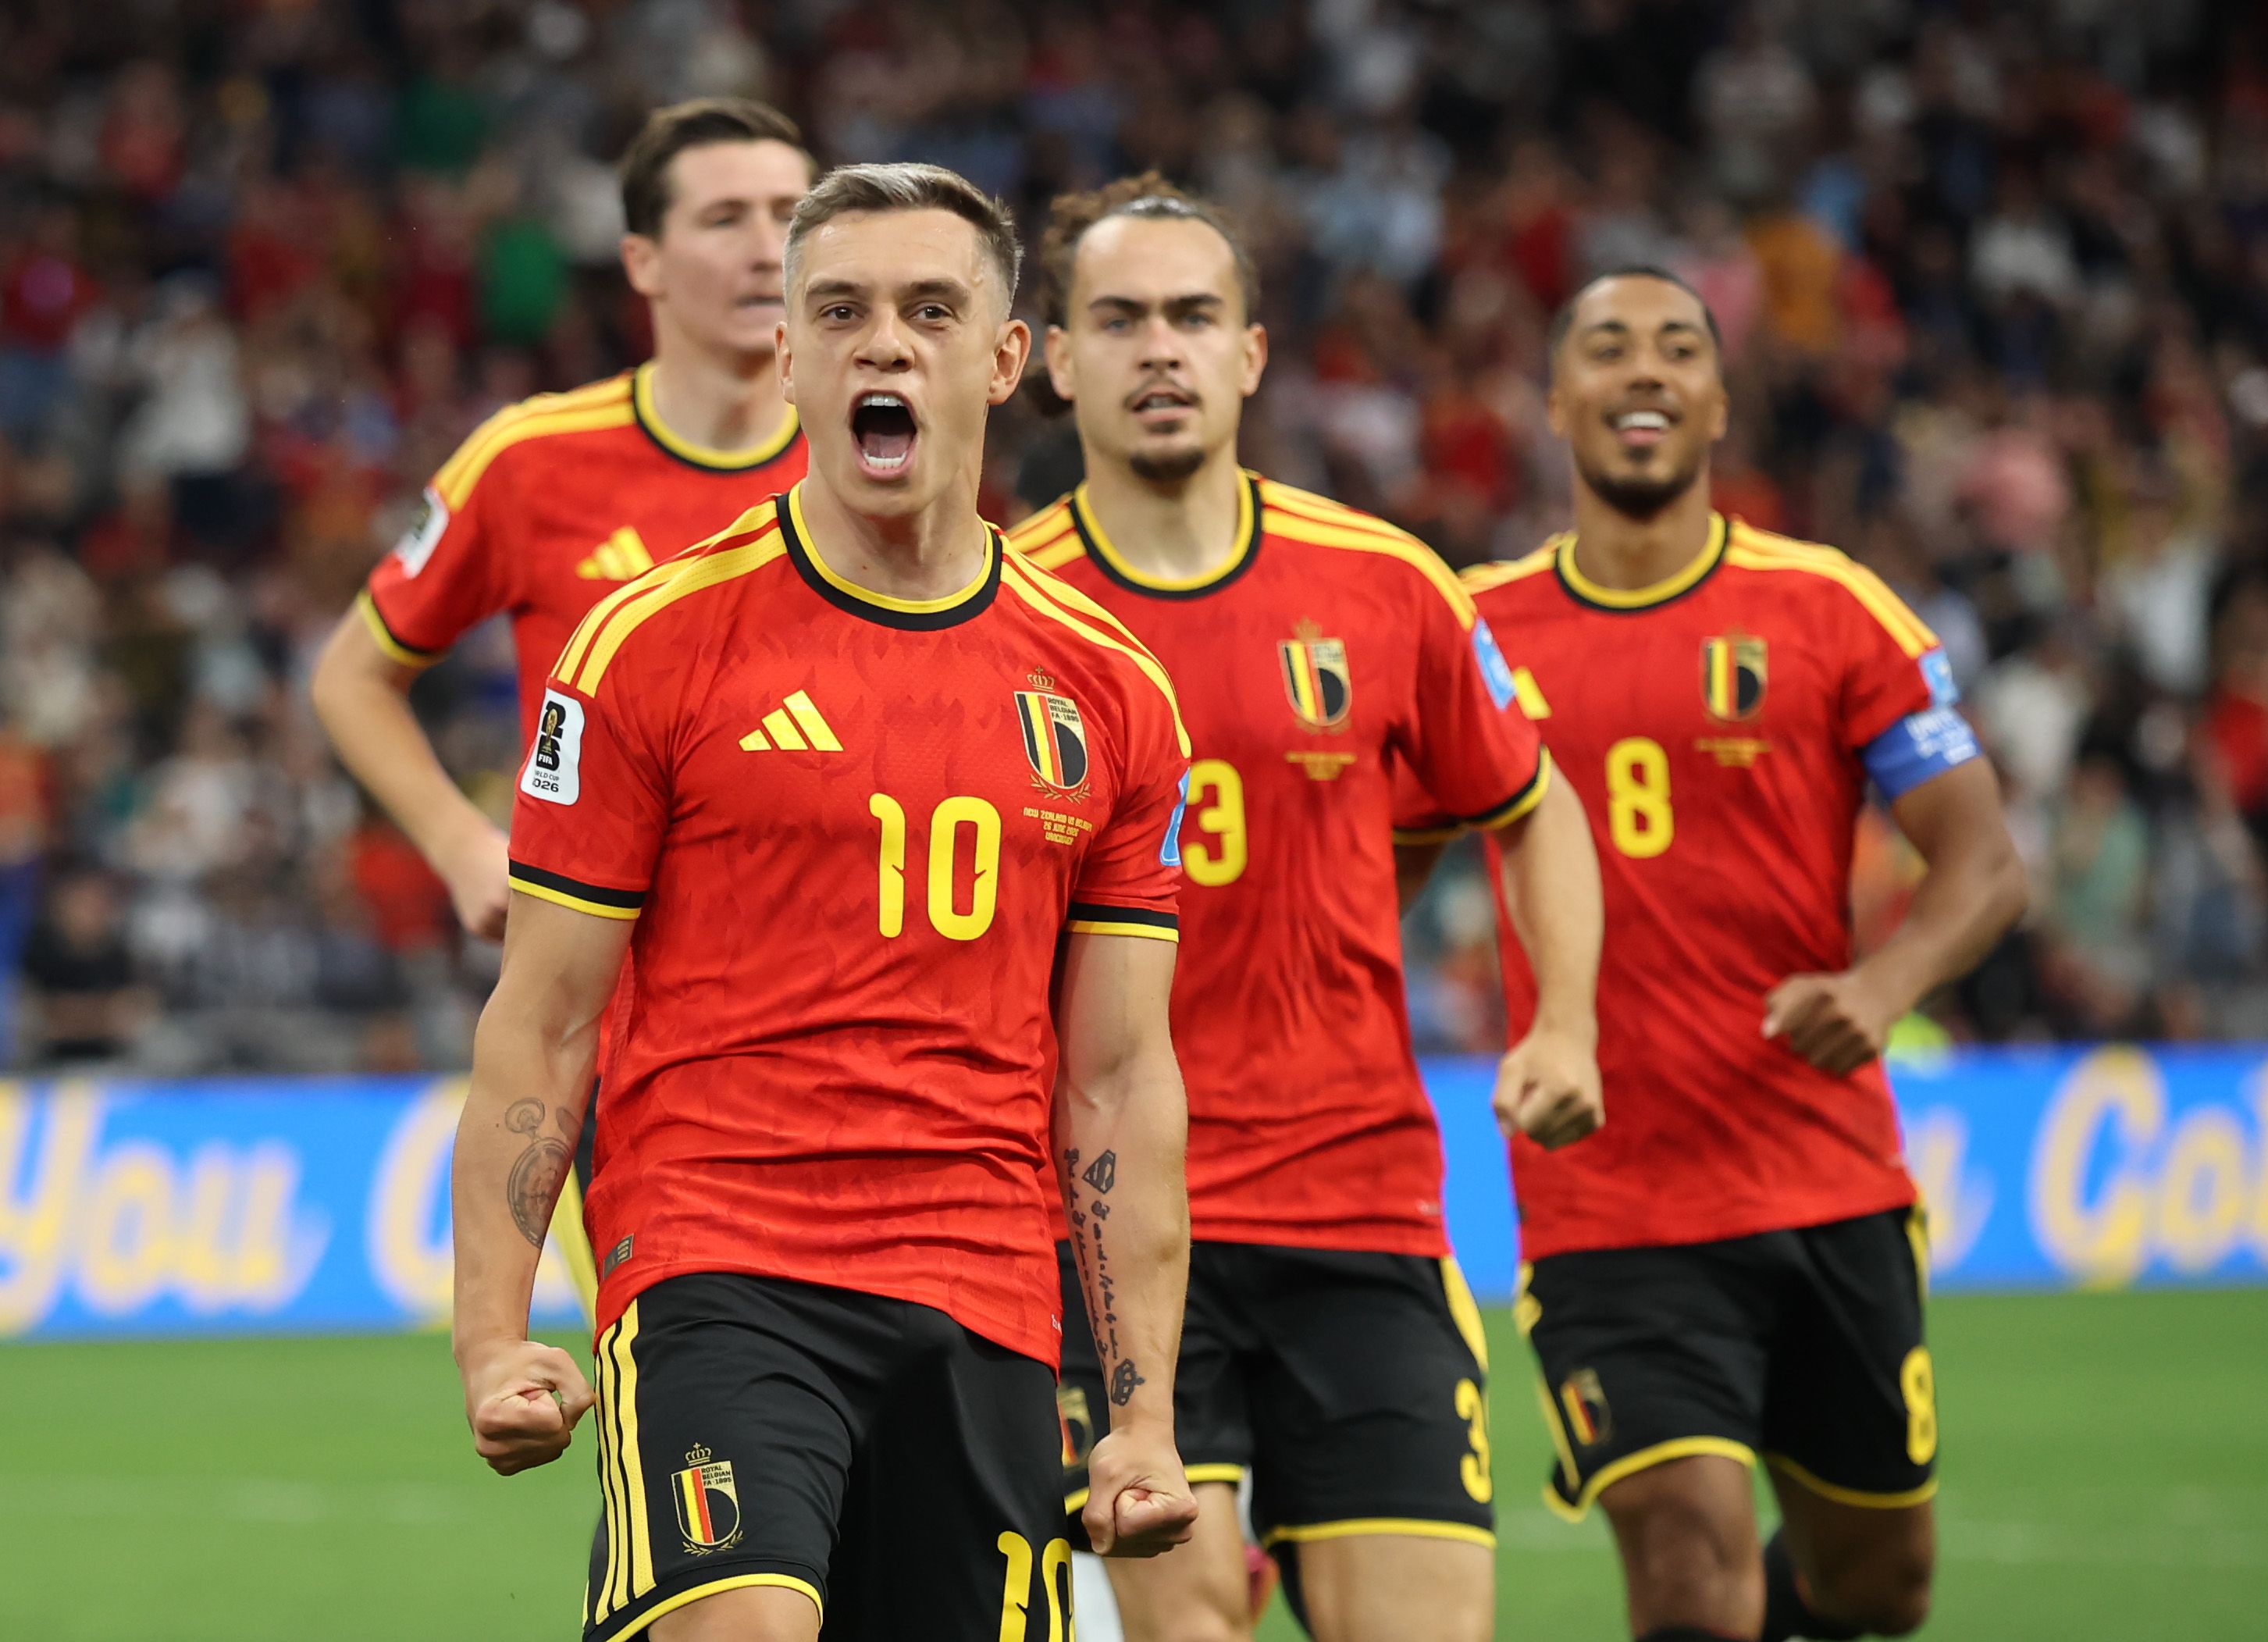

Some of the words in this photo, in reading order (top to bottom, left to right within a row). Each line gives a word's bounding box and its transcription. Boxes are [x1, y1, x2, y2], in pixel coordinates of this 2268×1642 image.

[1047, 697, 1067, 707] ROYAL
[1049, 705, 1077, 714] BELGIAN
[539, 753, 553, 765] FIFA
[1605, 736, 1675, 858] 8
[869, 793, 1002, 941] 10
[1183, 758, 1248, 886] 3
[1454, 1377, 1494, 1504] 3
[1899, 1345, 1938, 1466] 8
[702, 1465, 722, 1473] ROYAL
[703, 1470, 730, 1480] BELGIAN
[997, 1530, 1077, 1642] 10
